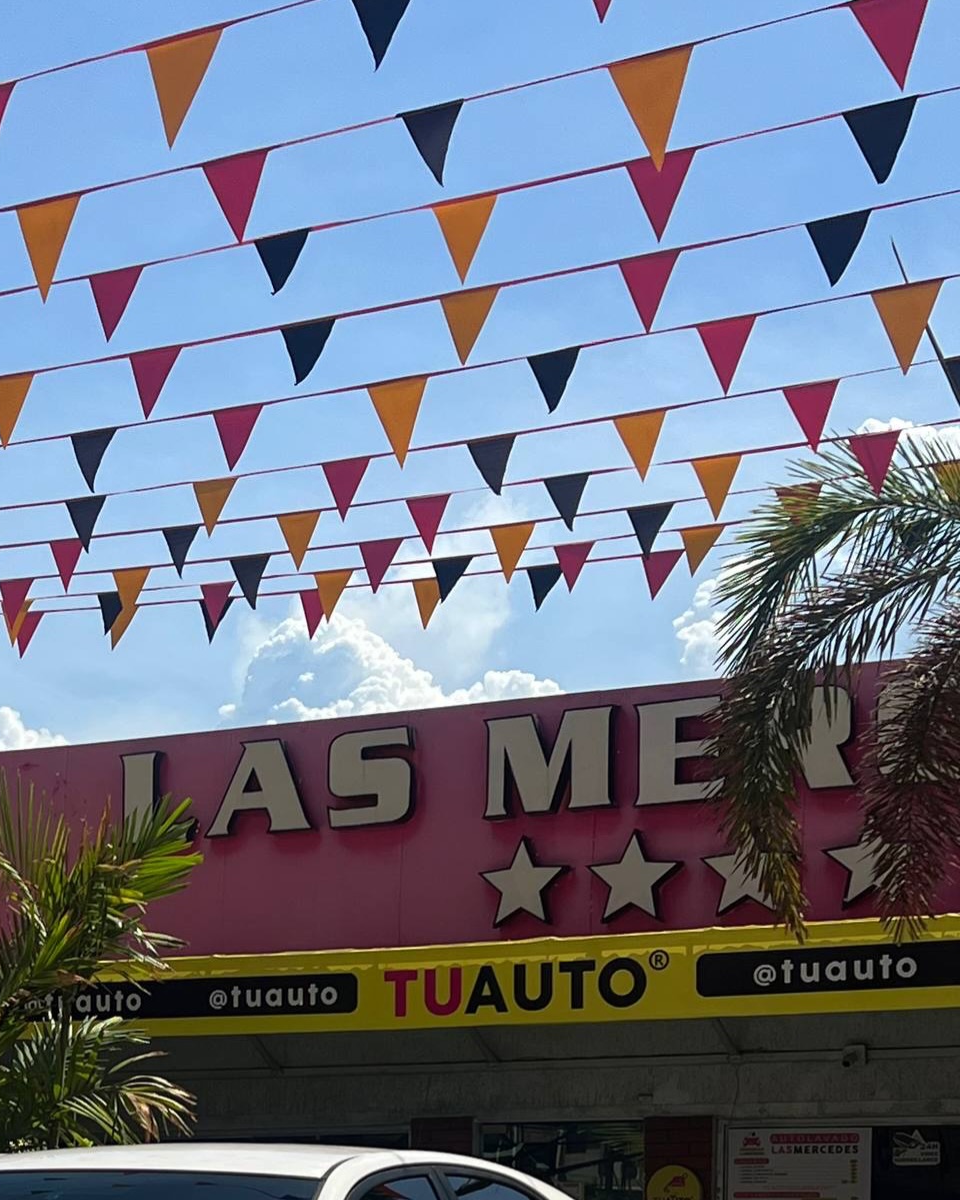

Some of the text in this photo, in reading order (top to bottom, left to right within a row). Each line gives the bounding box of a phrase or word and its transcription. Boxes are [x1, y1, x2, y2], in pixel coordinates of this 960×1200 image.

[121, 726, 417, 844] LAS
[753, 954, 917, 987] @tuauto
[208, 981, 339, 1010] @tuauto
[771, 1144, 859, 1155] LASMERCEDES
